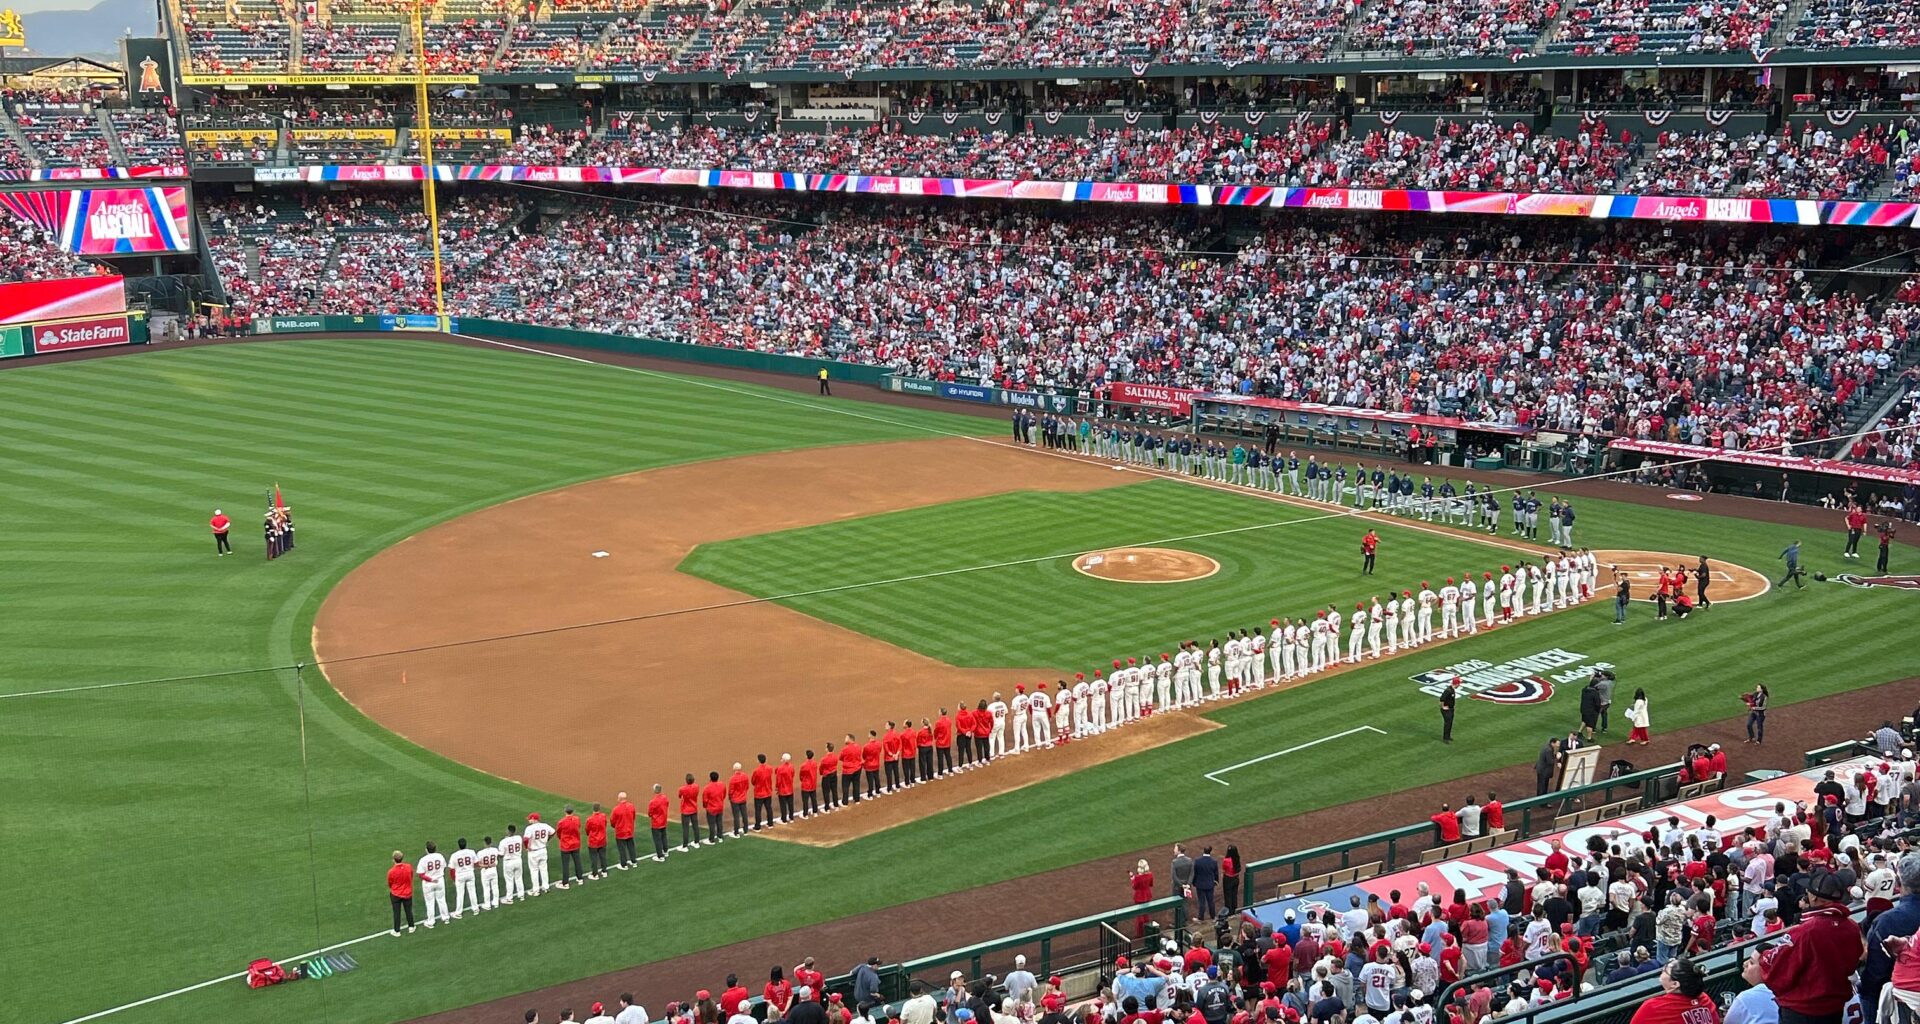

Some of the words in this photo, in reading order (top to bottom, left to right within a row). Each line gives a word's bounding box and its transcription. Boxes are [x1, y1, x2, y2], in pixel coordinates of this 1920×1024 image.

[351, 168, 382, 179] Angels
[529, 169, 555, 181] Angels
[871, 179, 896, 193] Angels
[1104, 187, 1134, 201] Angels
[1306, 192, 1343, 208] Angels
[1347, 190, 1383, 210] BASEBALL
[96, 199, 143, 215] Angels
[1652, 202, 1699, 219] Angels
[1706, 200, 1752, 221] BASEBALL
[90, 211, 153, 240] BASEBALL
[275, 320, 320, 329] FMB.com
[904, 382, 933, 392] FMB.com
[958, 388, 984, 398] HYUNDAI
[1124, 386, 1171, 402] SALINAS,
[1010, 392, 1035, 406] Modelo
[1140, 398, 1157, 406] Carpet
[1158, 400, 1180, 409] Cleaning
[1505, 648, 1590, 672] WEEK
[1880, 879, 1894, 892] 27
[1538, 935, 1548, 948] 18
[1371, 975, 1386, 988] 21
[1681, 1007, 1713, 1024] NETO
